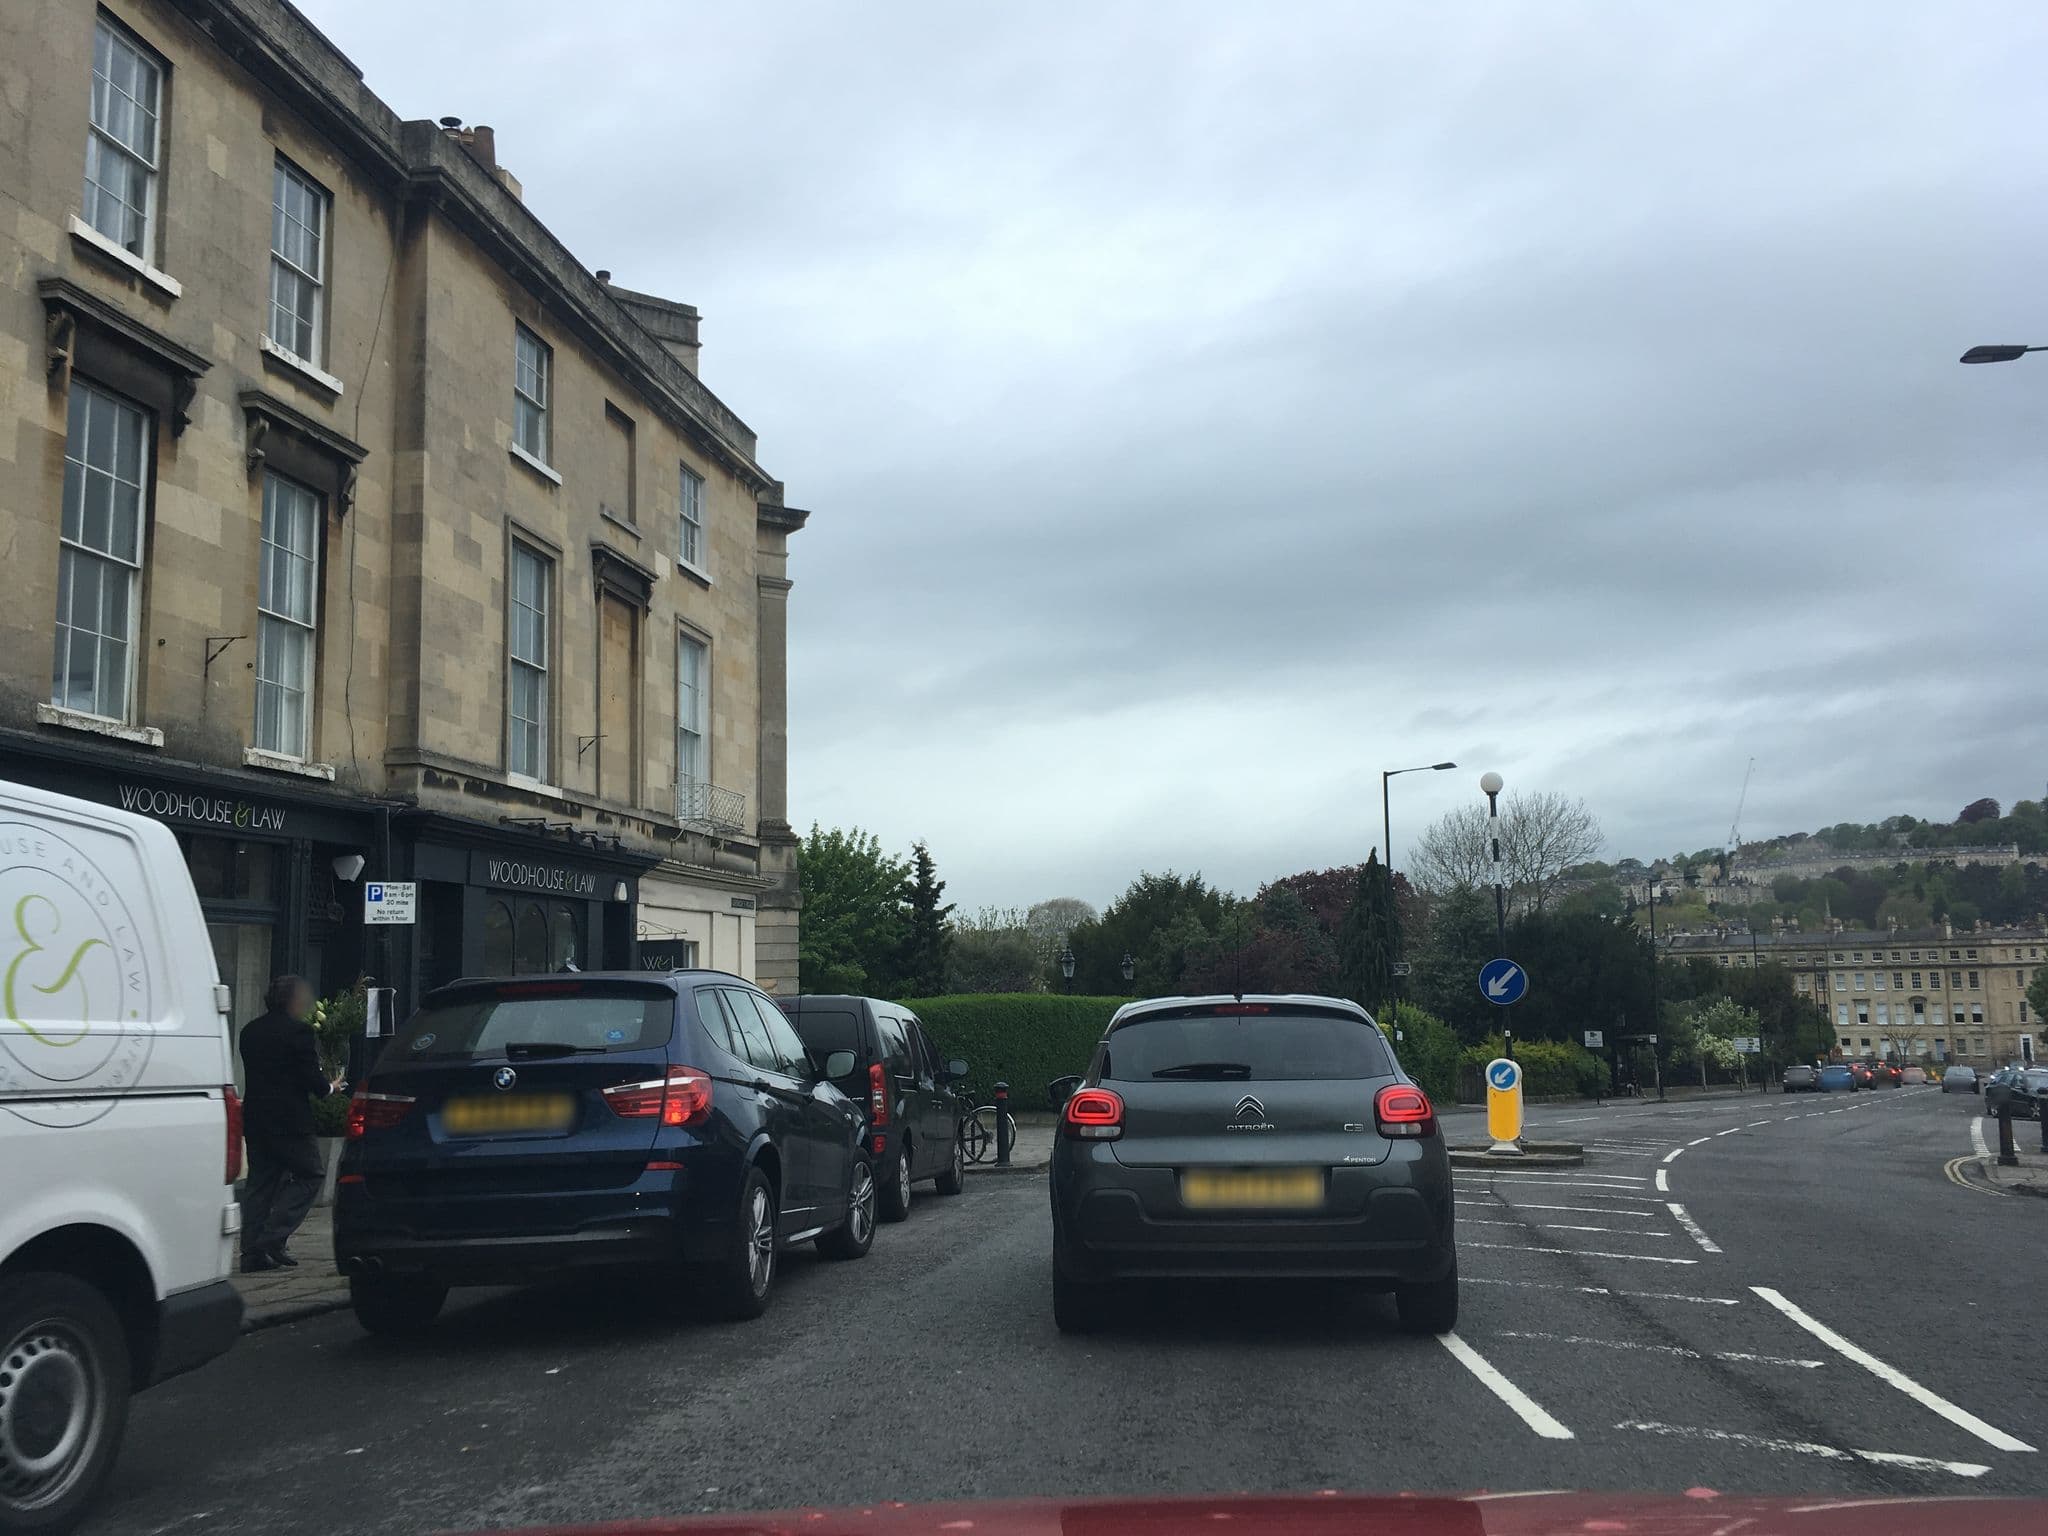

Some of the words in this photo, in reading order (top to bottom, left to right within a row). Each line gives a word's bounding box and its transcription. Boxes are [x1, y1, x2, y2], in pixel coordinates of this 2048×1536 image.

[119, 784, 232, 824] WOODHOUSE
[235, 801, 250, 828] &
[252, 806, 286, 831] LAW
[489, 860, 564, 890] WOODHOUSE
[574, 873, 596, 893] LAW
[371, 887, 381, 900] P
[1344, 1123, 1364, 1132] C3
